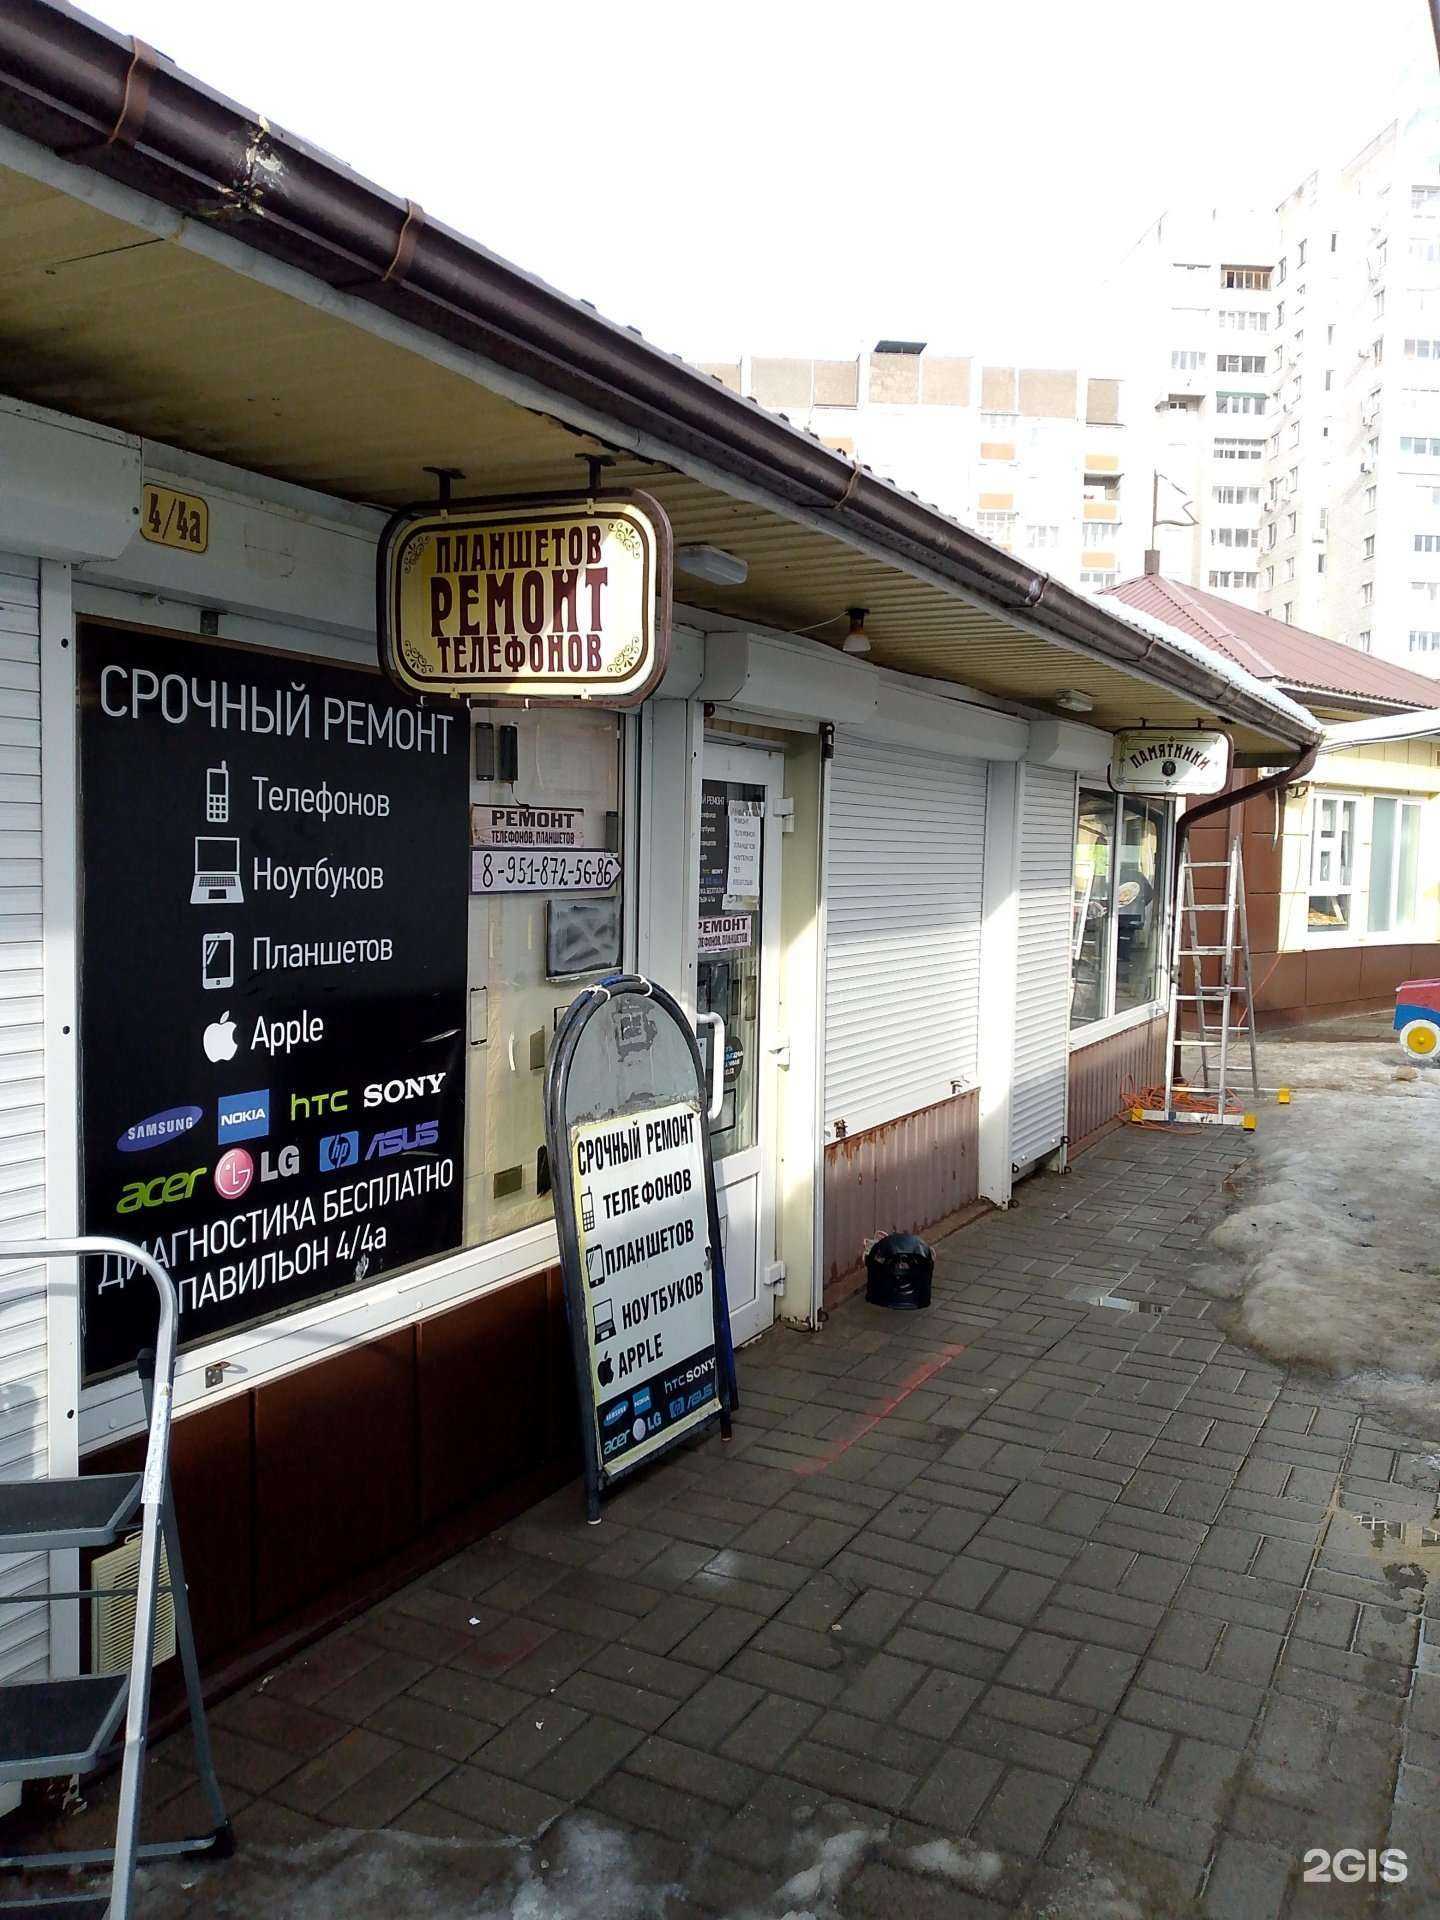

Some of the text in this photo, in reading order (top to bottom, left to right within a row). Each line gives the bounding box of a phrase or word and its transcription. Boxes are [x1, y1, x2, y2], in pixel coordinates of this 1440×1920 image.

[435, 526, 601, 573] ПЛАНШЕТОВ
[431, 567, 608, 637] РЕМОНТ
[437, 634, 602, 673] ТЕЛЕФОНОВ
[100, 665, 454, 754] СРОЧНЫЙ РЕМОНТ
[1129, 743, 1210, 771] ПАМЯТНИКИ
[252, 776, 390, 822] Телефонов
[492, 810, 574, 829] РЕМОНТ
[492, 830, 574, 846] ТЕЛЕФОНОВ, ПЛАНШЕТОВ
[253, 857, 384, 898] Ноутбуков
[253, 937, 393, 970] Планшетов
[250, 1009, 324, 1056] Apple
[127, 1072, 447, 1141] SAMSUNG NOKIA htc SONY
[116, 1167, 207, 1214] acer
[261, 1145, 300, 1182] LG
[365, 1120, 439, 1160] ASUS
[577, 1113, 694, 1176] СРОЧНЫЙ РЕМОНТ
[323, 1158, 454, 1222] БЕСПЛАТНО
[603, 1168, 692, 1219] ТЕЛЕФОНОВ
[178, 1223, 387, 1314] ПАВИЛЬОН 4/4а
[605, 1218, 694, 1276] ПЛАНШЕТОВ
[622, 1271, 704, 1330] НОУТБУКОВ
[618, 1332, 664, 1379] APPLE
[686, 1357, 716, 1384] SONY
[603, 1428, 631, 1455] acer
[647, 1411, 662, 1430] LG
